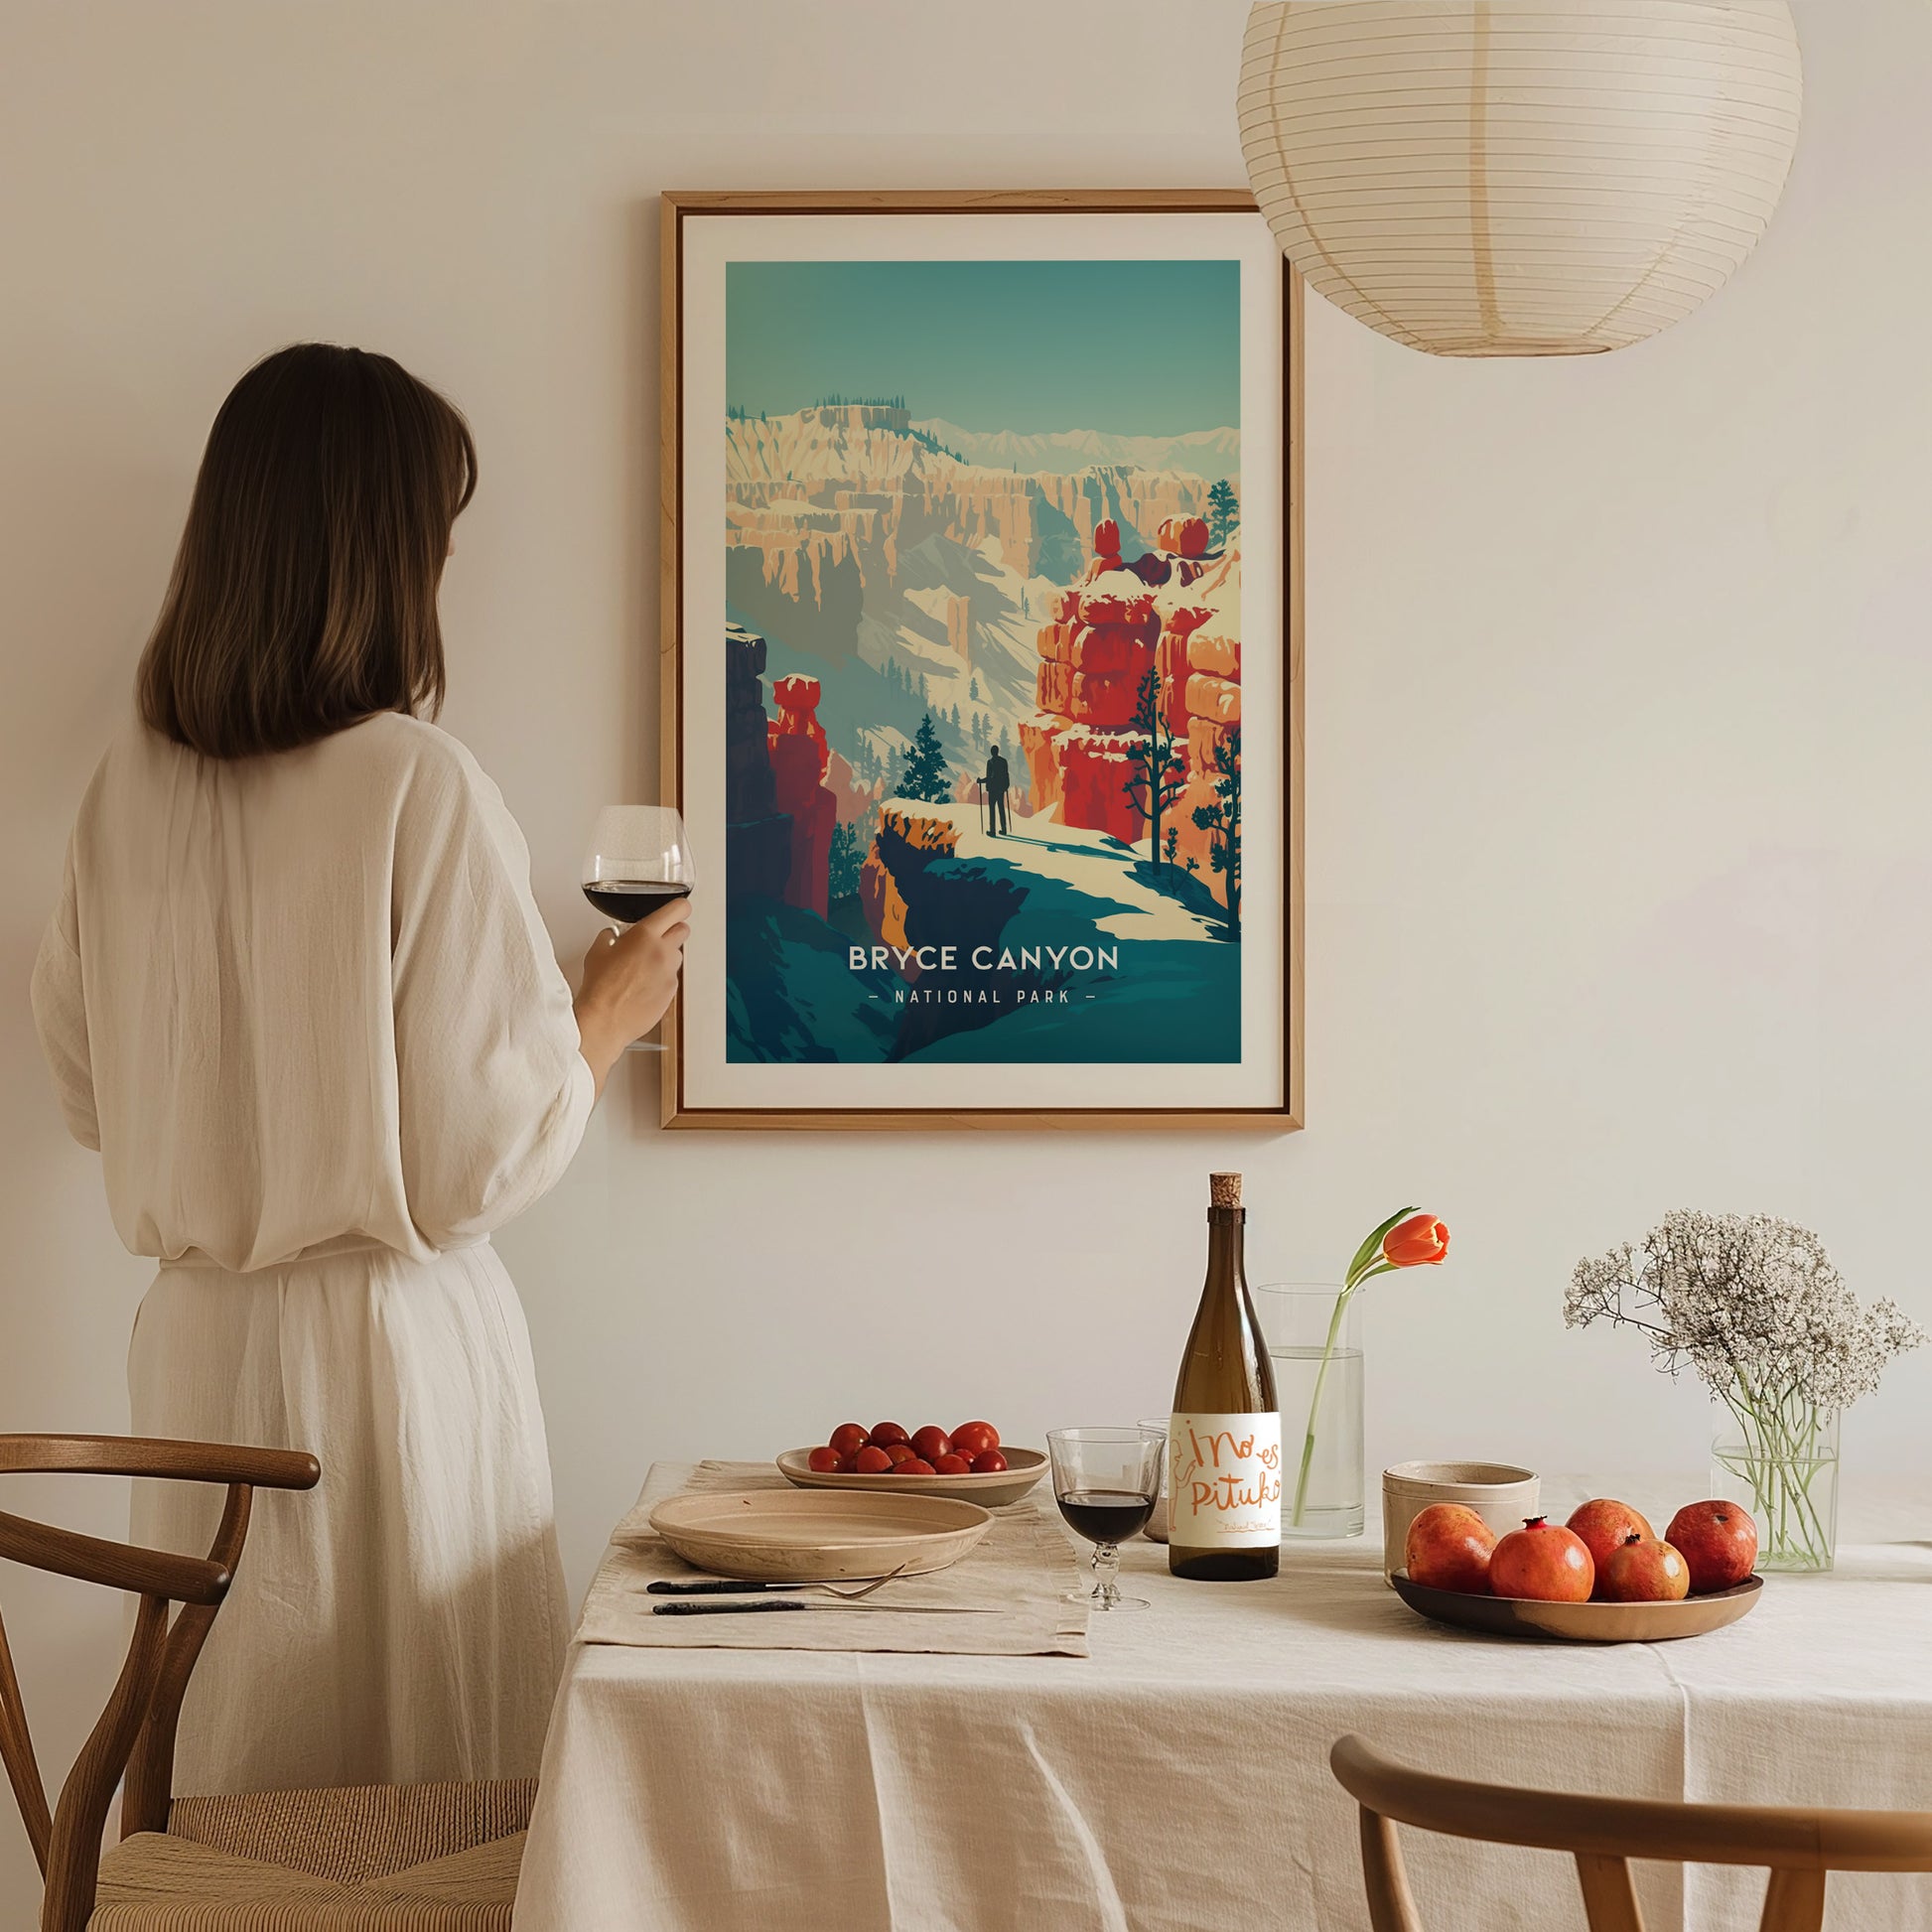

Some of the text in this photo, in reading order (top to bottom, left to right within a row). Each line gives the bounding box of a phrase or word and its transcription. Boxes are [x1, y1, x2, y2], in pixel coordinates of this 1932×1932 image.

[849, 945, 1118, 970] BRYCE CANYON
[896, 990, 1069, 1004] NATIONAL PARK
[1256, 1444, 1279, 1469] es
